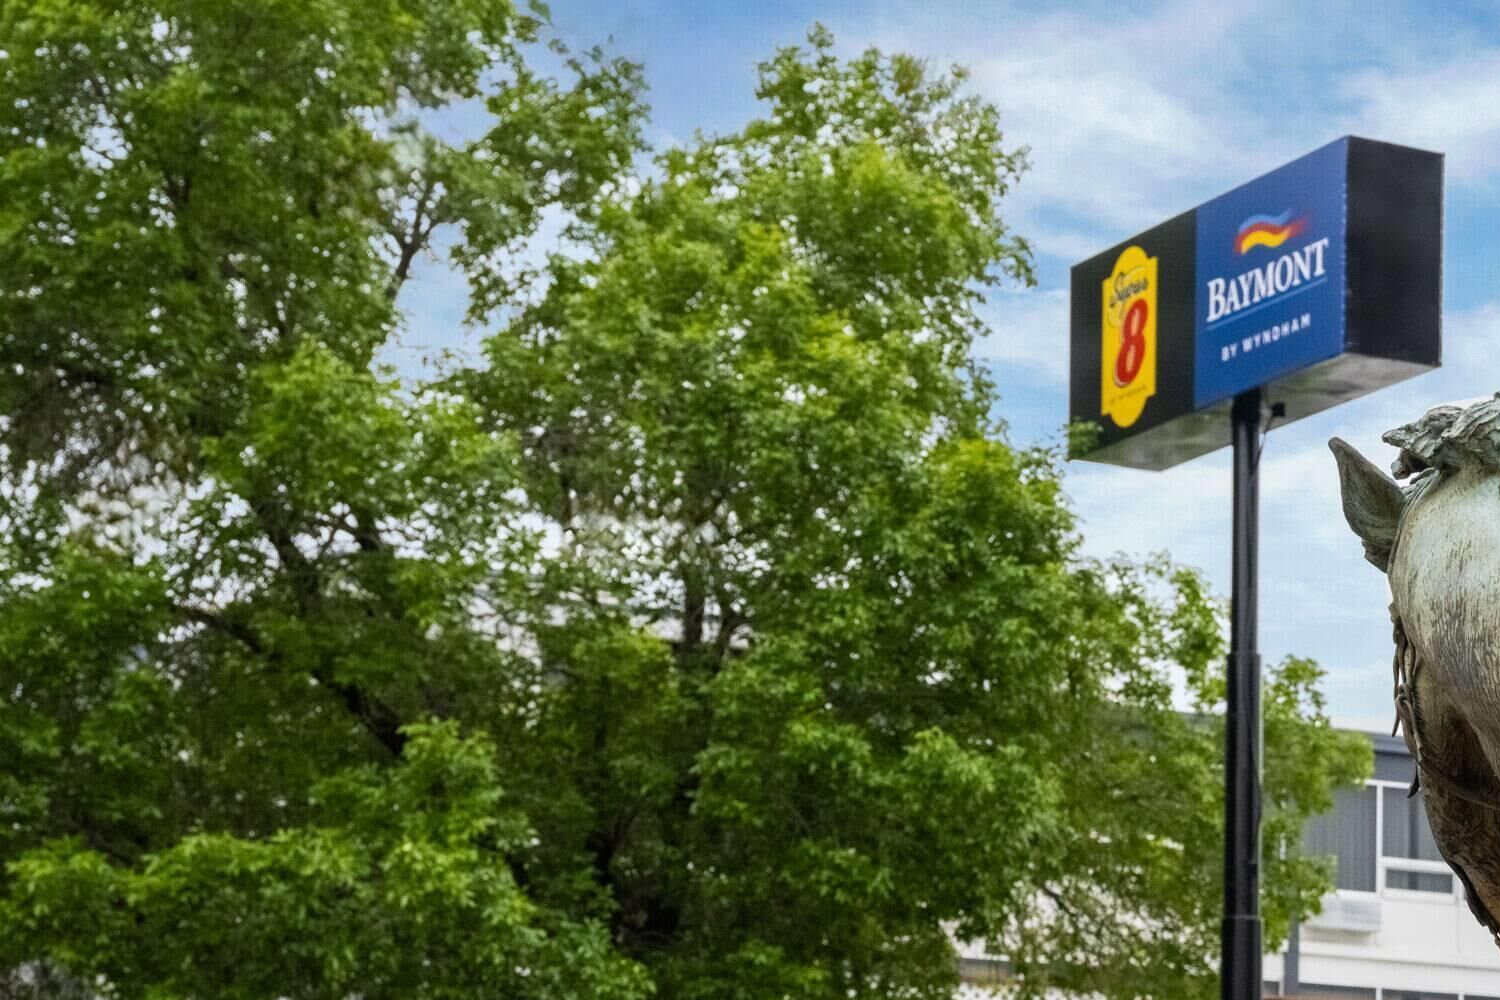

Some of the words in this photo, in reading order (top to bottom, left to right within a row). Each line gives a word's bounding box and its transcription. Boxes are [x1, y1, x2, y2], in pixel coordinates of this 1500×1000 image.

[1109, 271, 1149, 308] Super
[1206, 238, 1329, 322] BAYMONT
[1113, 298, 1149, 387] 8
[1221, 344, 1238, 362] BY
[1242, 313, 1311, 353] WYNDHAM
